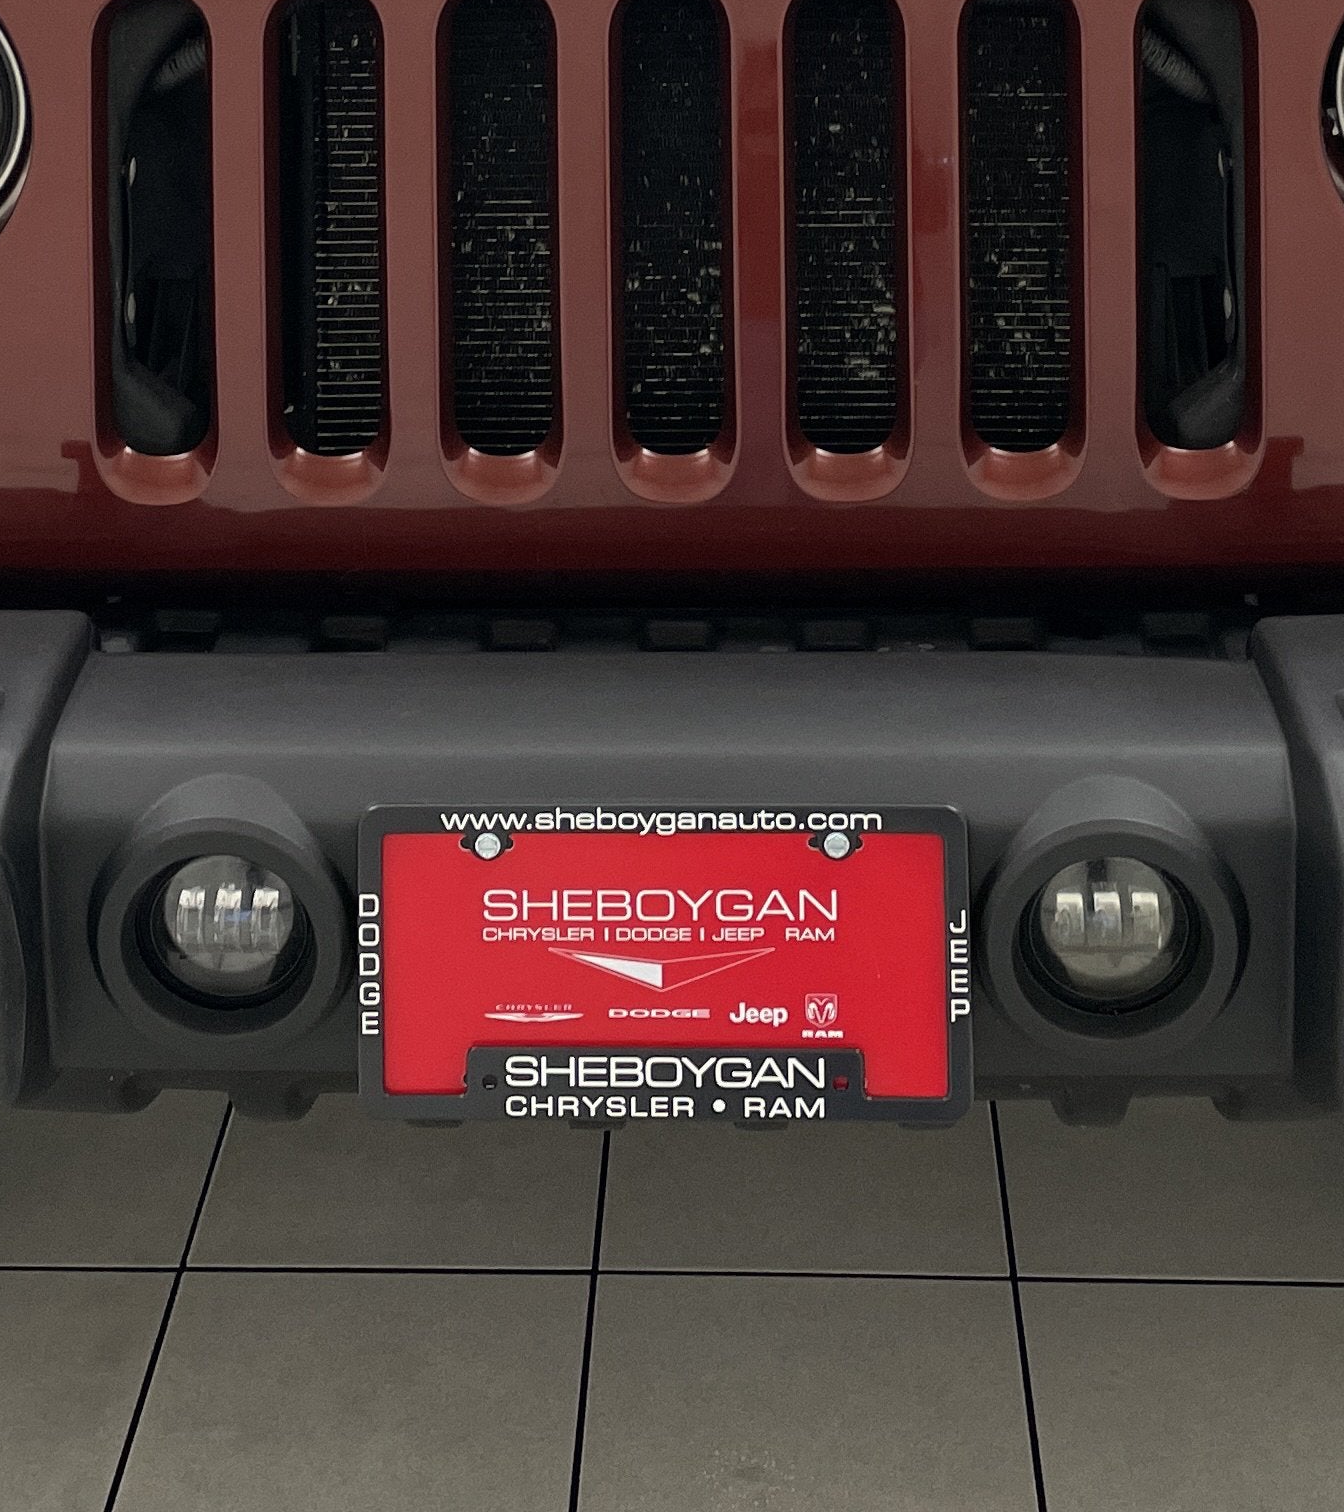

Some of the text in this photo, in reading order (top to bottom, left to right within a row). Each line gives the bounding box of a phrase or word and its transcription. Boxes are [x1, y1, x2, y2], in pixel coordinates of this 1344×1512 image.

[440, 806, 882, 836] www.sheboyganauto.com
[482, 889, 838, 922] SHEBOYGAN
[482, 927, 836, 942] CHRYSLER DODGE JEEP RAM
[358, 893, 381, 1035] DODGE
[949, 909, 971, 1023] JEEP
[608, 1008, 711, 1019] DODGE
[729, 1002, 789, 1028] Jeep
[505, 1056, 825, 1089] SHEBOYGAN
[505, 1095, 826, 1119] CHRYSLER RAM
